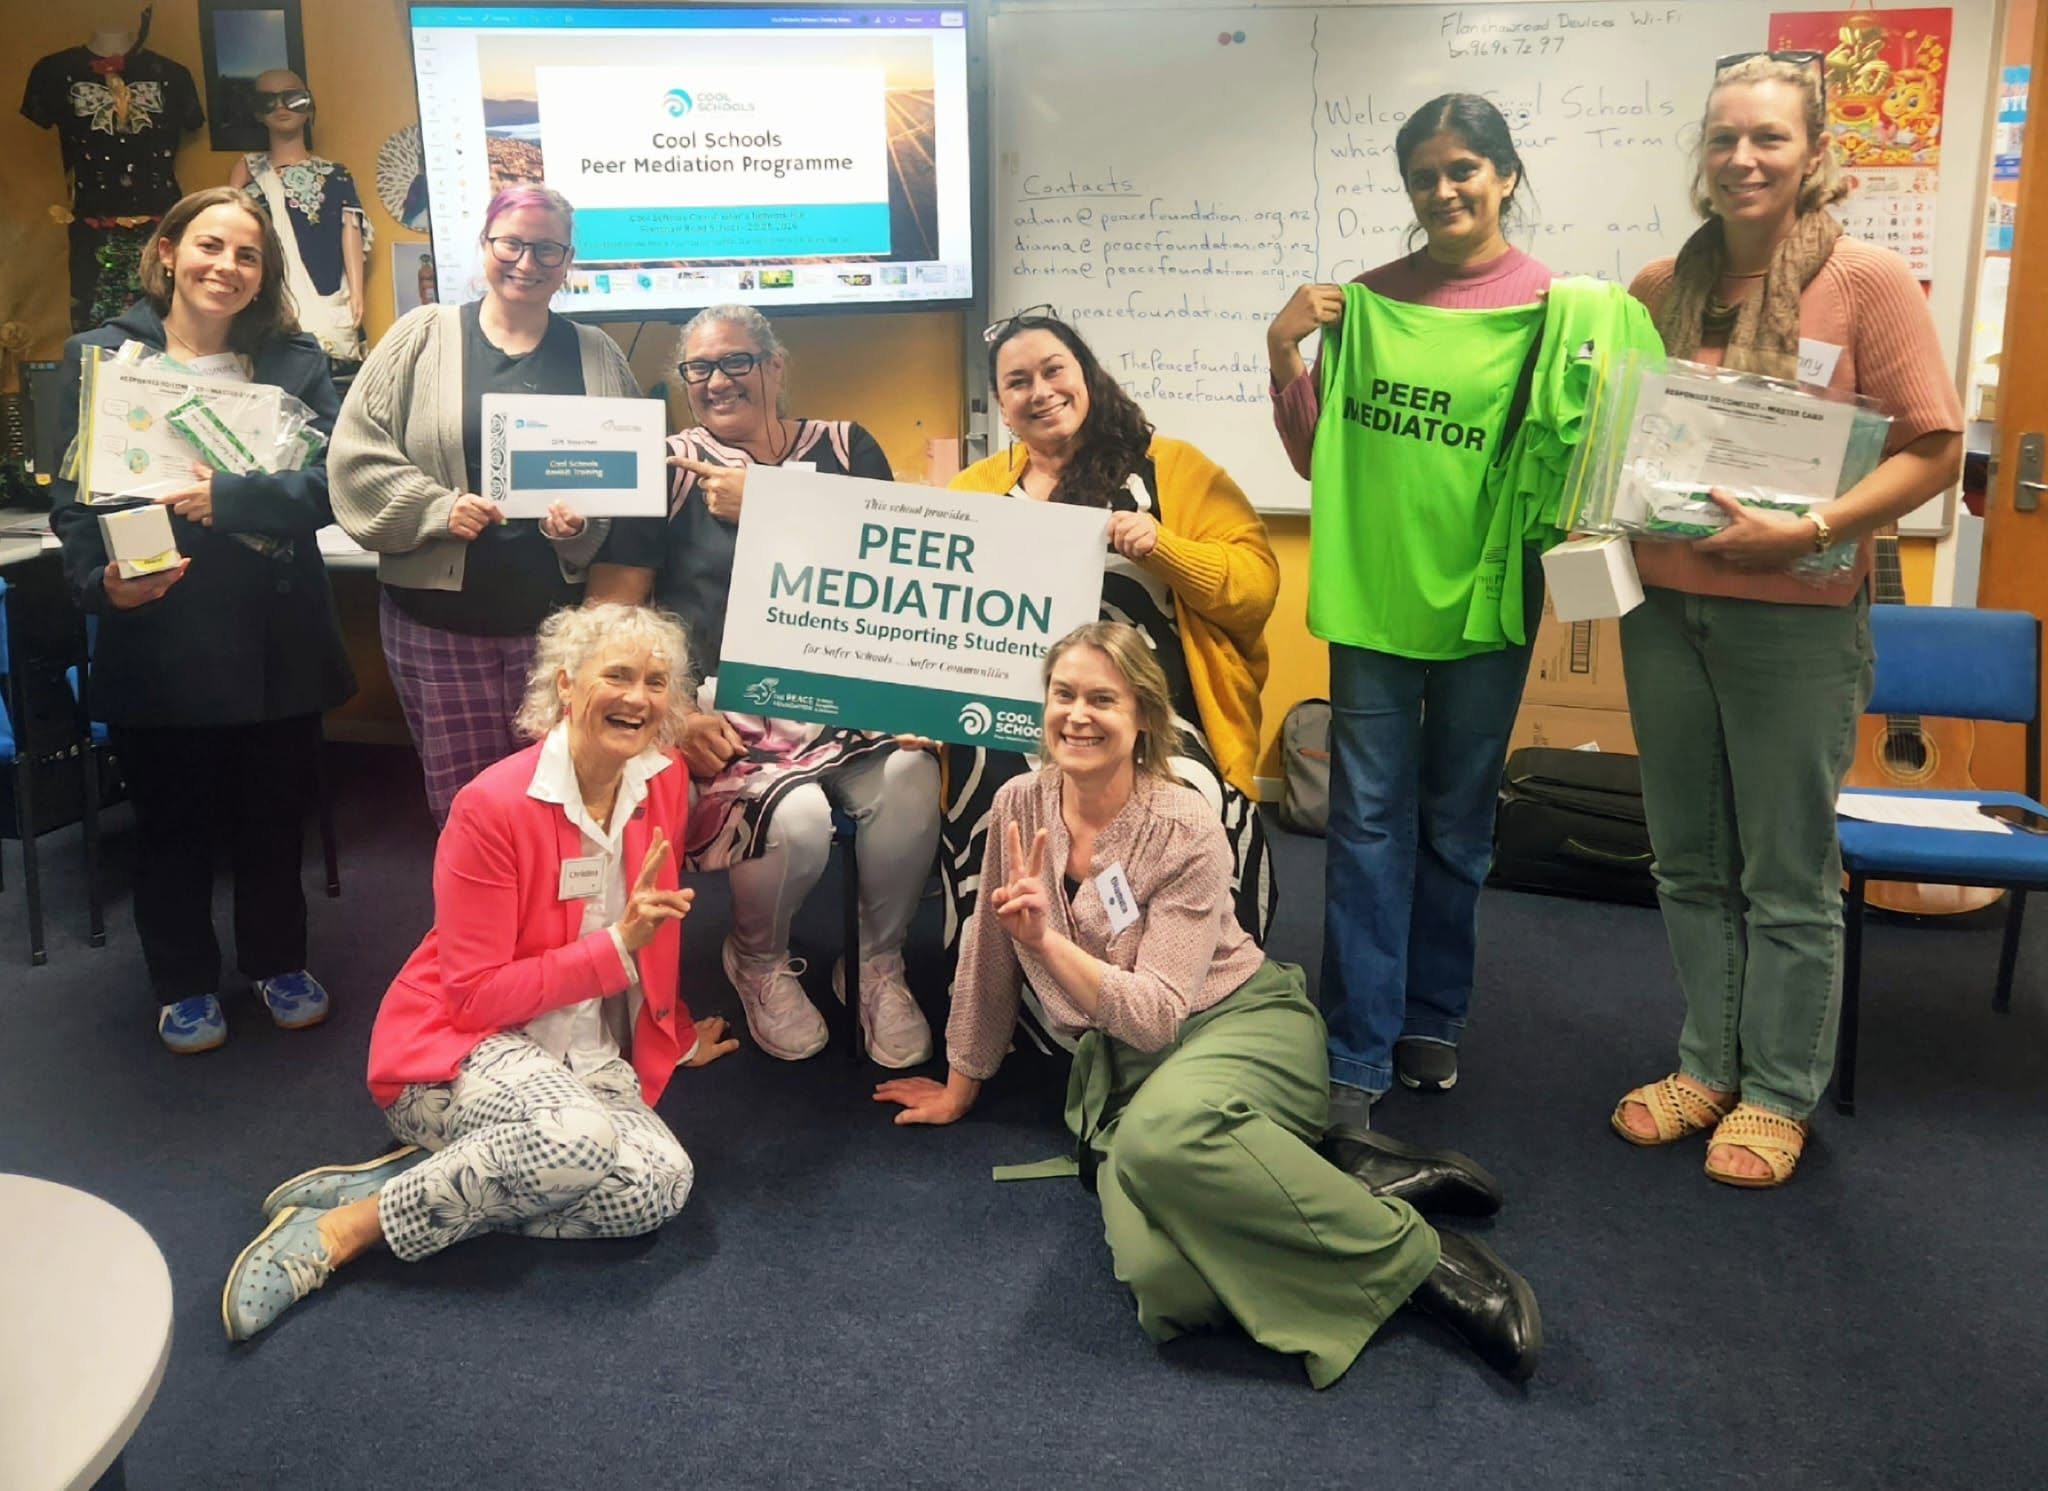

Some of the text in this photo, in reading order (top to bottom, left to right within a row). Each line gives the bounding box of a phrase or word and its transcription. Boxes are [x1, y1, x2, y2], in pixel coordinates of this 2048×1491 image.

[1325, 94, 1406, 125] Welco
[1562, 80, 1674, 118] Schools
[652, 130, 783, 149] Cool Schools
[1585, 127, 1663, 148] Term
[581, 156, 853, 178] Peer Mediation Programme
[1023, 166, 1134, 195] Contacts
[1336, 170, 1402, 194] netw
[1607, 204, 1663, 238] and
[1371, 378, 1452, 415] PEER
[1343, 397, 1487, 452] MEDIATOR
[864, 498, 887, 510] This
[890, 504, 923, 515] school
[858, 523, 975, 573] PEER
[769, 562, 1053, 634] MEDIATION
[766, 606, 1048, 659] Students Supporting Students
[803, 643, 819, 655] for
[823, 645, 850, 660] Safer
[855, 650, 893, 664] Schools
[907, 658, 936, 671] Safer
[939, 662, 1009, 680] Communities
[995, 723, 1043, 738] SCHOO
[996, 711, 1035, 725] COOL
